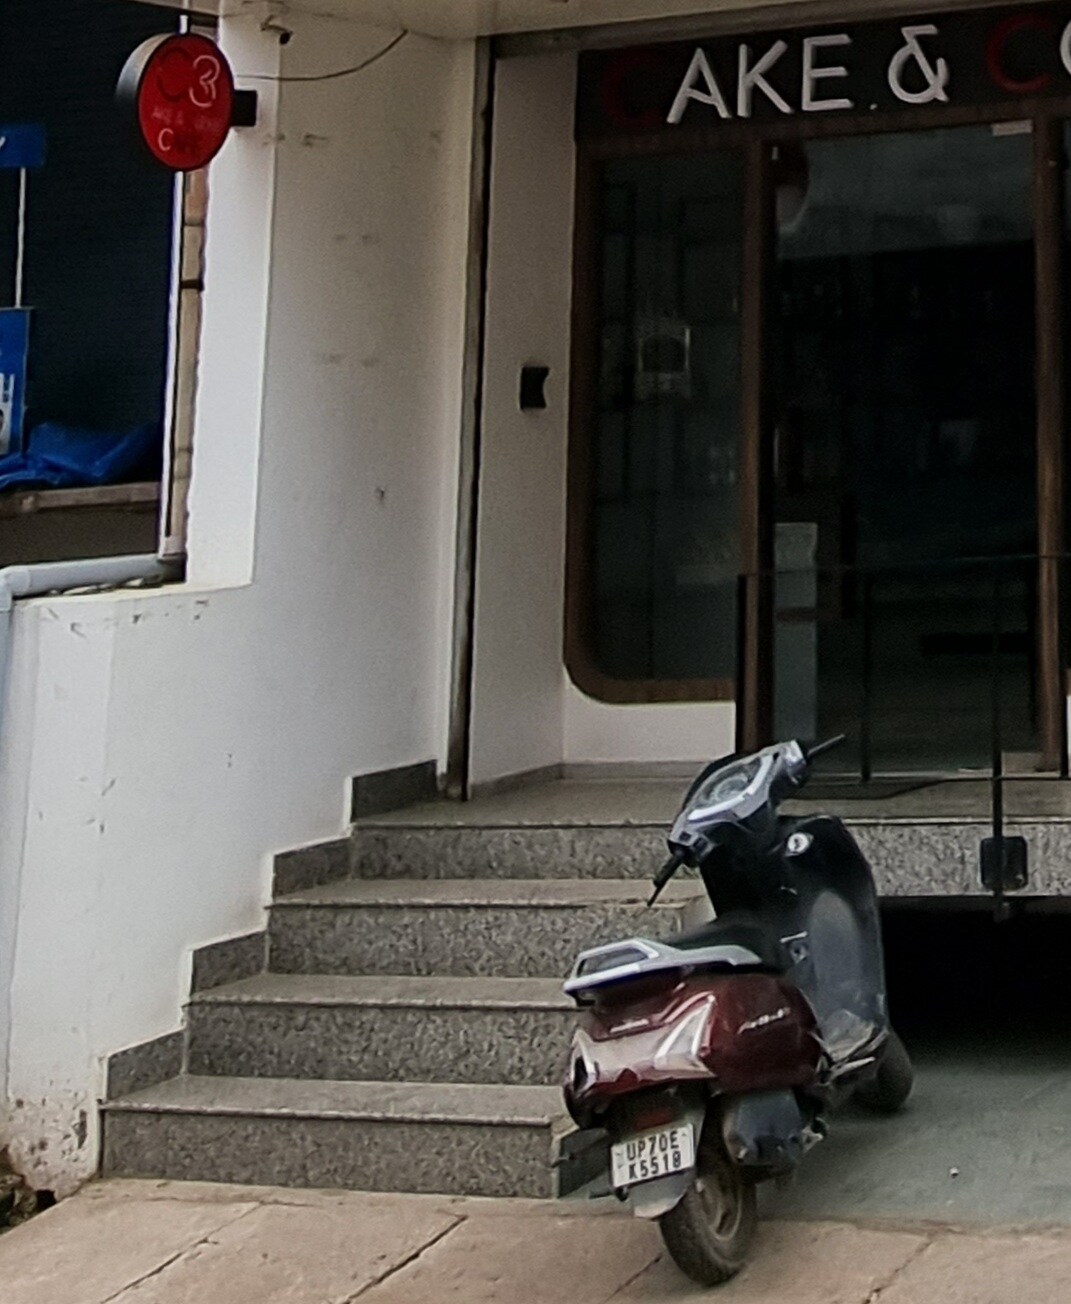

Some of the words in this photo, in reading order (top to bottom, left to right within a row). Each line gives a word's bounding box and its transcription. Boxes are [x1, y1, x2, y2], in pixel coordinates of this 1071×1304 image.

[601, 33, 853, 128] CAKE
[887, 25, 949, 103] &
[627, 1130, 679, 1160] UP70E
